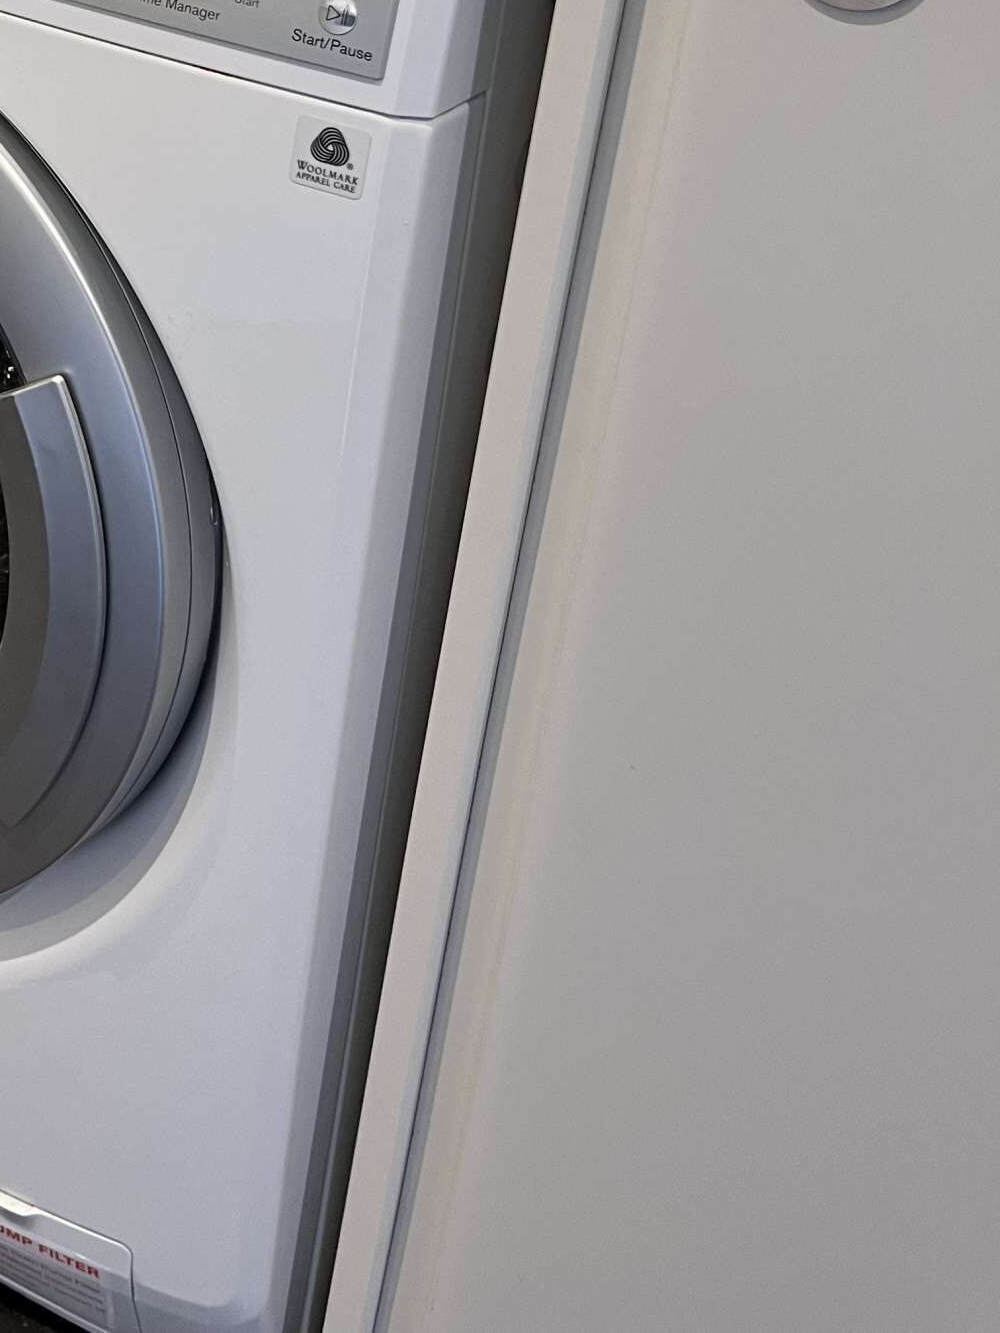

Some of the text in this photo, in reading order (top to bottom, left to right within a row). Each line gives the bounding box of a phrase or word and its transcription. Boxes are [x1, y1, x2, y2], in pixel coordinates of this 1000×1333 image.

[291, 28, 373, 62] Start/Pause
[296, 171, 356, 193] APPAREL CARE
[297, 160, 359, 185] WOOLMARK
[38, 1243, 100, 1279] FILTER
